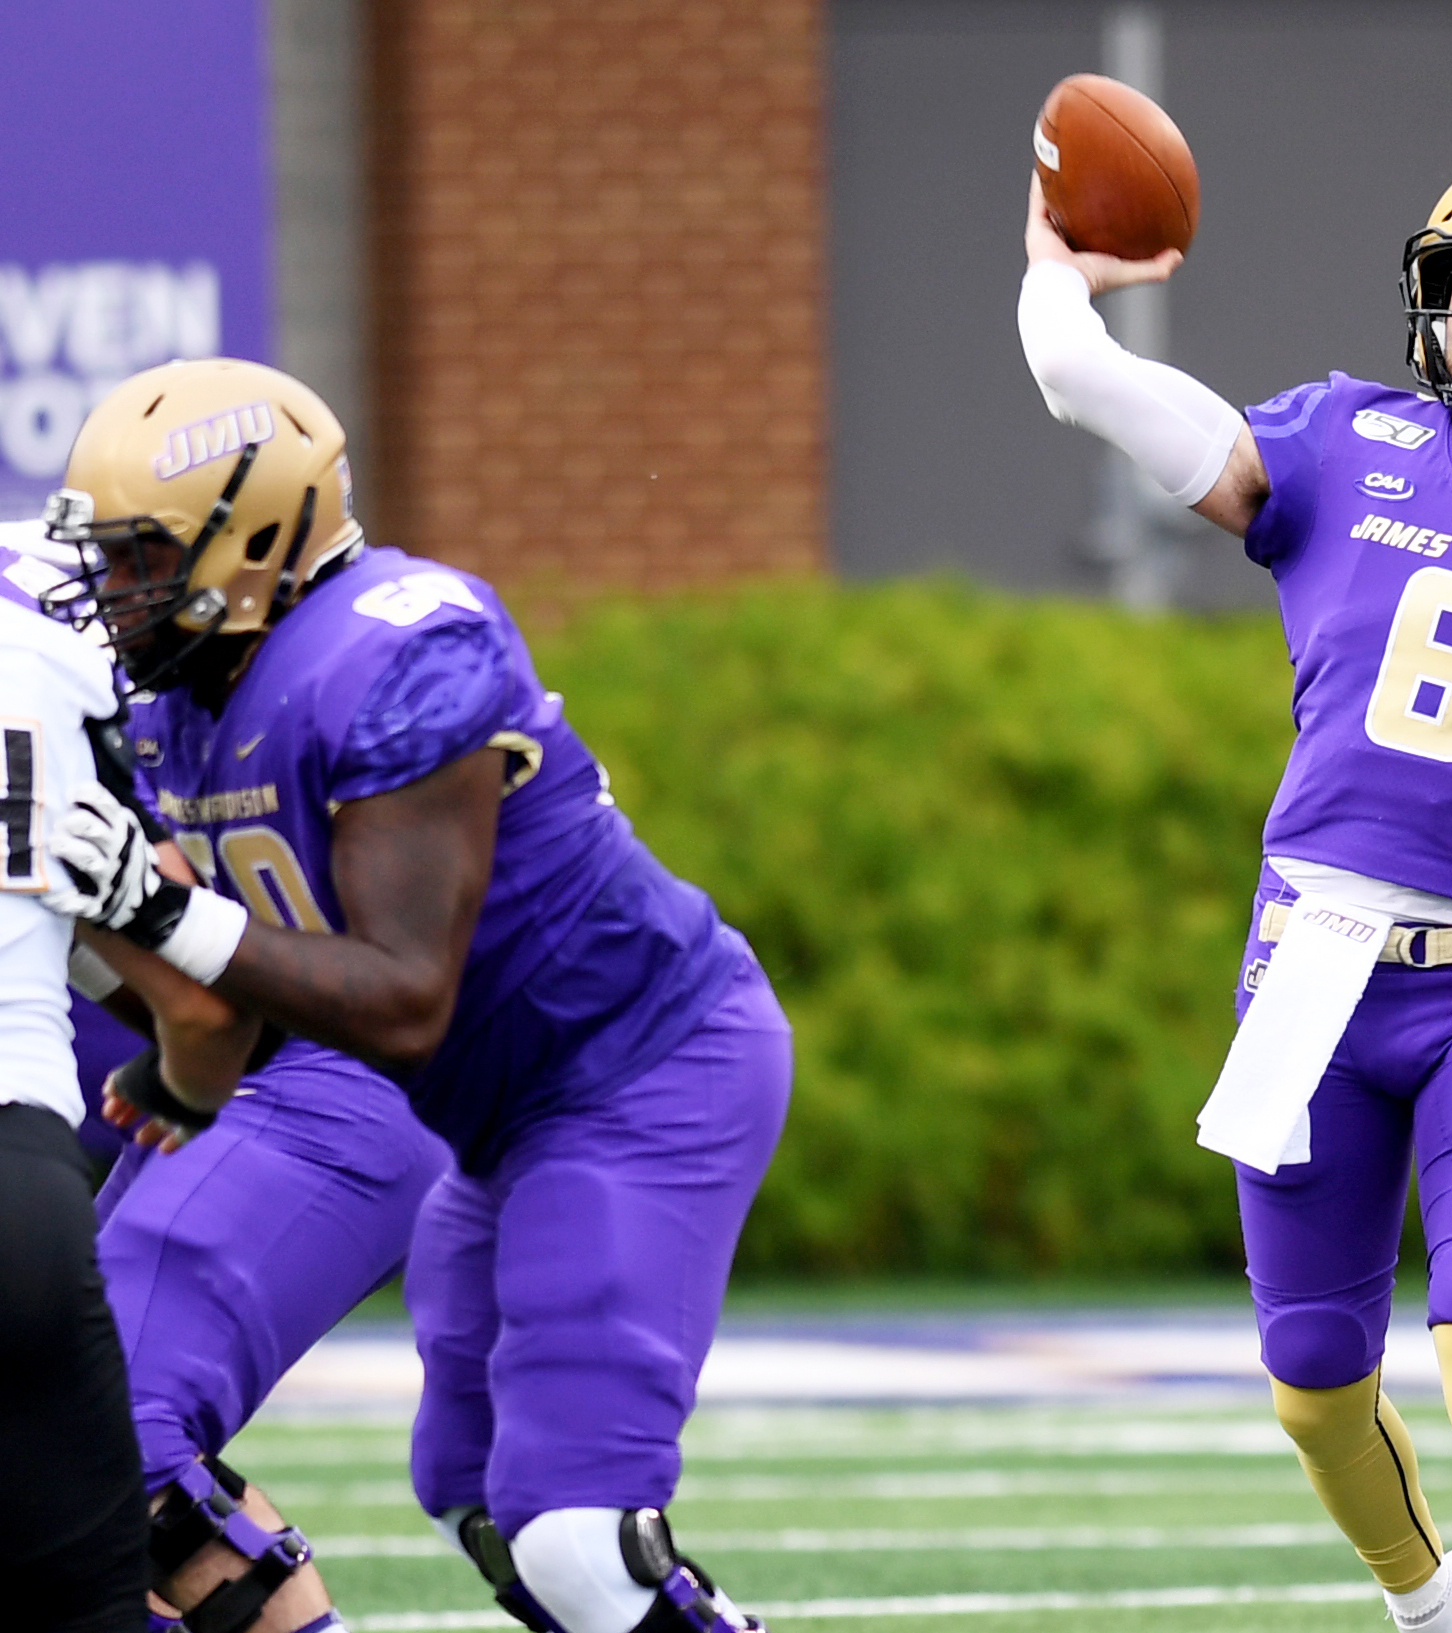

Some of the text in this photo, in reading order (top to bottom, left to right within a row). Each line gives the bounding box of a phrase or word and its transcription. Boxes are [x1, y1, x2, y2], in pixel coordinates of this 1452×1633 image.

[154, 402, 275, 480] JMU
[1353, 409, 1436, 450] 150
[1364, 472, 1407, 493] CAA
[1303, 909, 1377, 943] JMU
